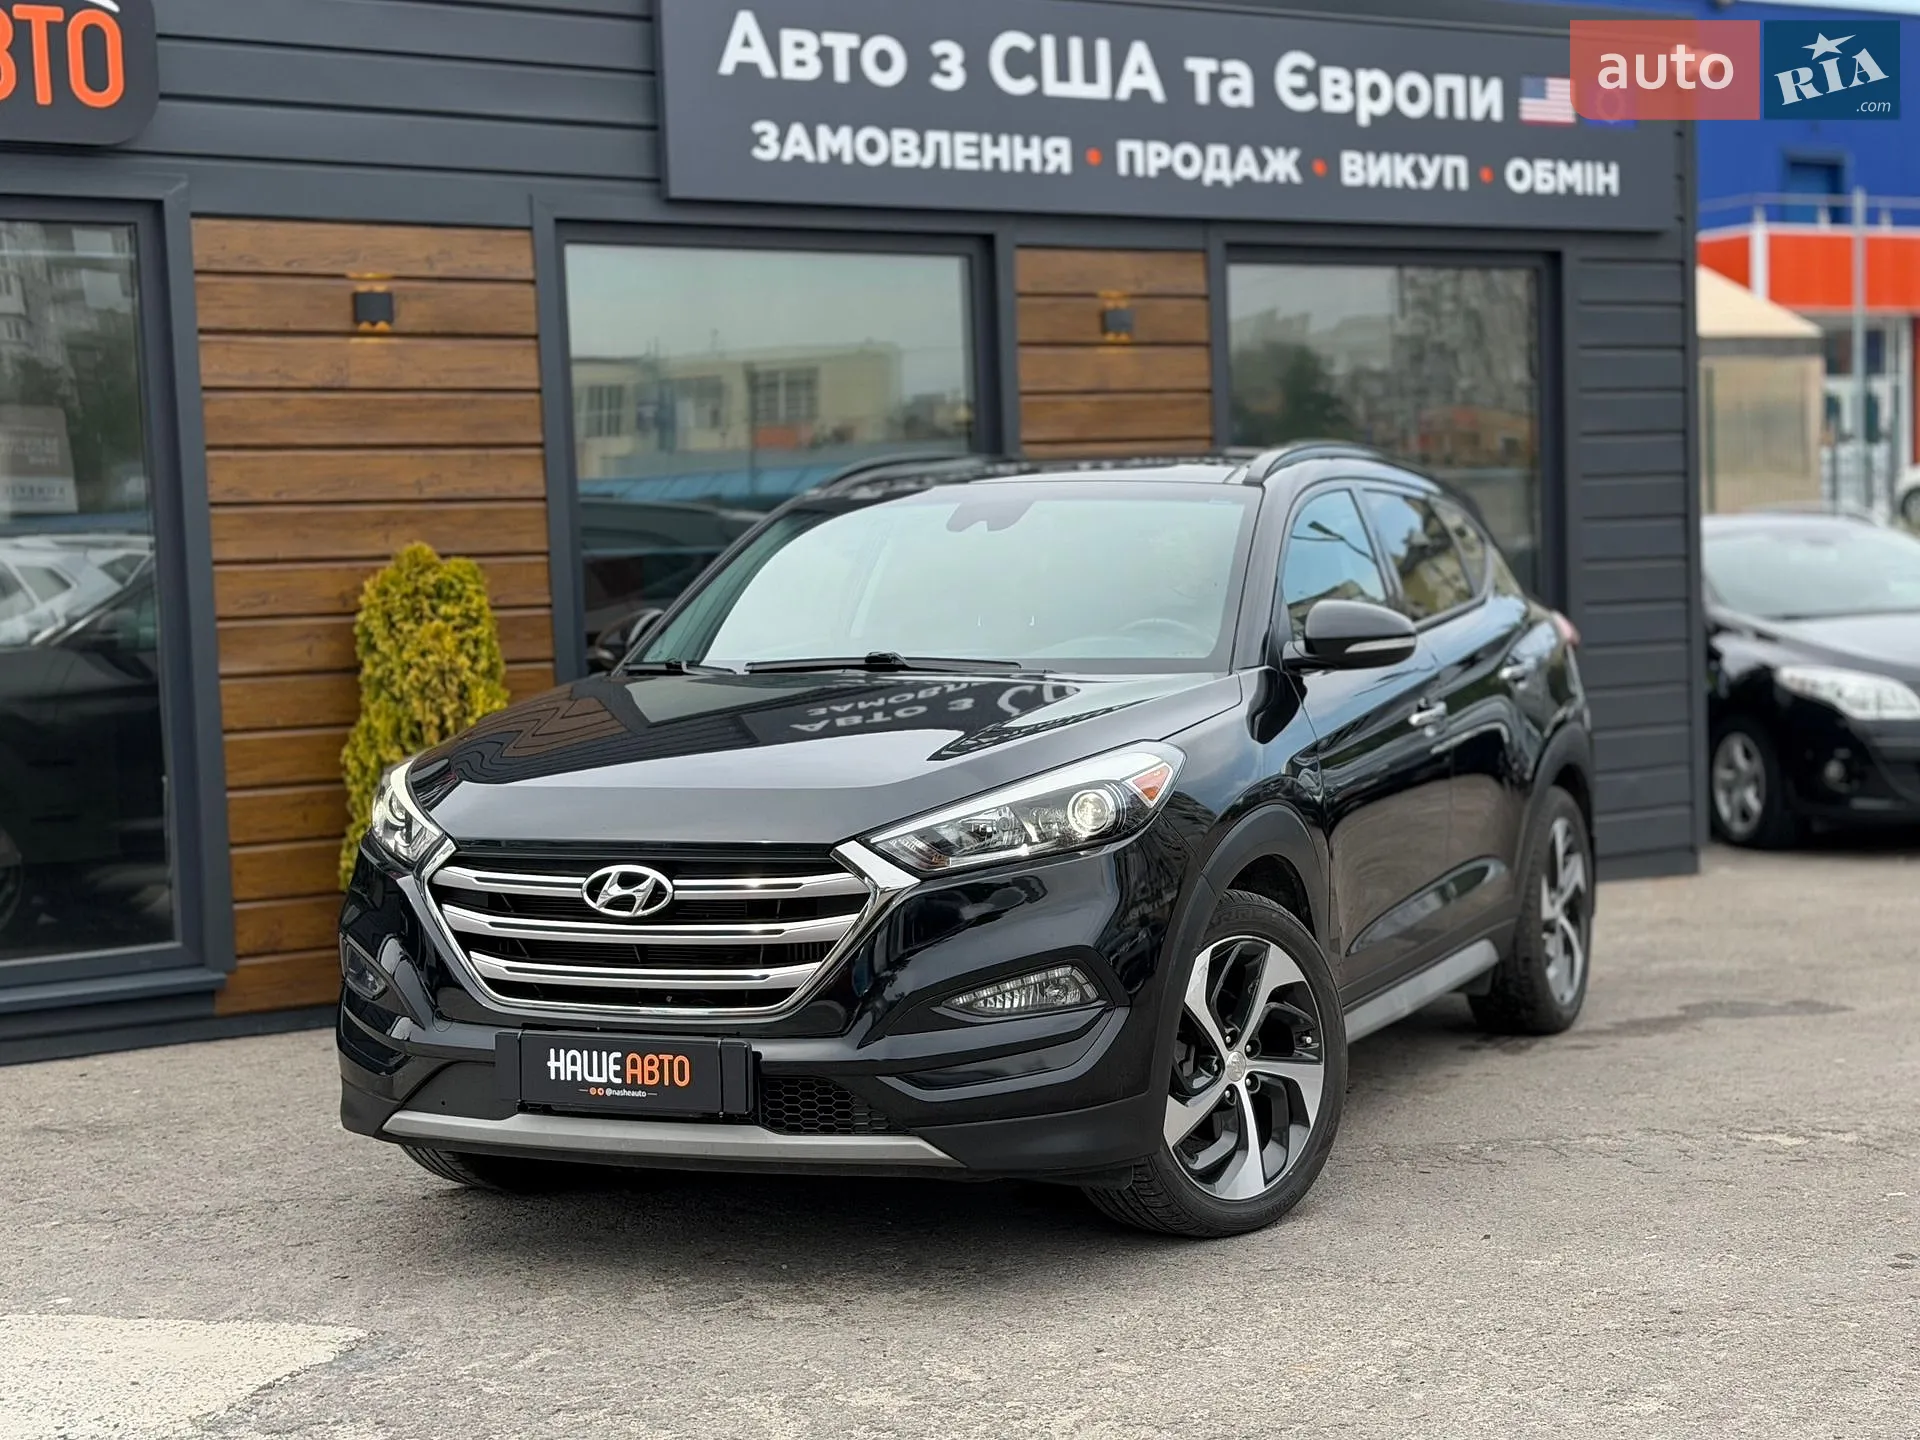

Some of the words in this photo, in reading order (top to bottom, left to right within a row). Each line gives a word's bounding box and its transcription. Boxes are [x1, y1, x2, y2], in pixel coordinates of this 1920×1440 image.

[718, 9, 908, 88] Авто
[930, 39, 967, 91] з
[988, 30, 1166, 103] США
[1184, 57, 1254, 108] та
[1274, 50, 1503, 127] Європи
[751, 121, 1072, 175] ЗАМОВЛЕННЯ
[1116, 139, 1302, 187] ПРОДАЖ
[1340, 150, 1469, 190] ВИКУП
[1505, 158, 1619, 197] ОБМІН
[546, 1047, 623, 1084] НАШЕ
[626, 1052, 690, 1087] АВТО
[605, 1088, 647, 1098] @nasheauto
